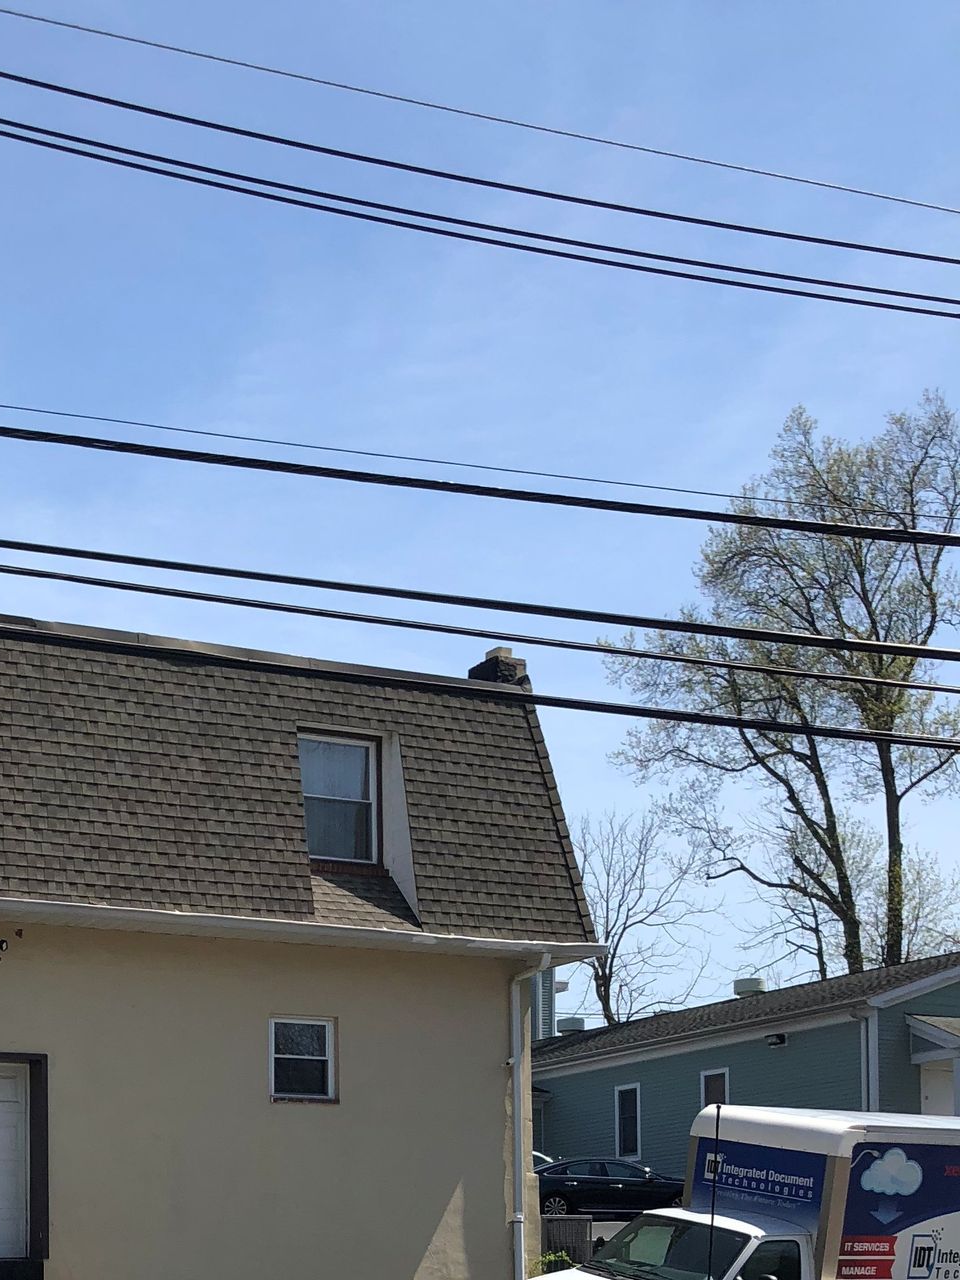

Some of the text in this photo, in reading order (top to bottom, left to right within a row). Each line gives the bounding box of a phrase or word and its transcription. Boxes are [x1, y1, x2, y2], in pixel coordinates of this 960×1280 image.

[723, 1163, 814, 1188] Integrated Document
[722, 1174, 813, 1198] Technologies
[844, 1242, 890, 1251] IT SERVICES
[913, 1246, 934, 1268] IDT
[937, 1248, 960, 1266] Inte
[841, 1266, 877, 1275] MANAGE
[935, 1267, 960, 1279] Tec
